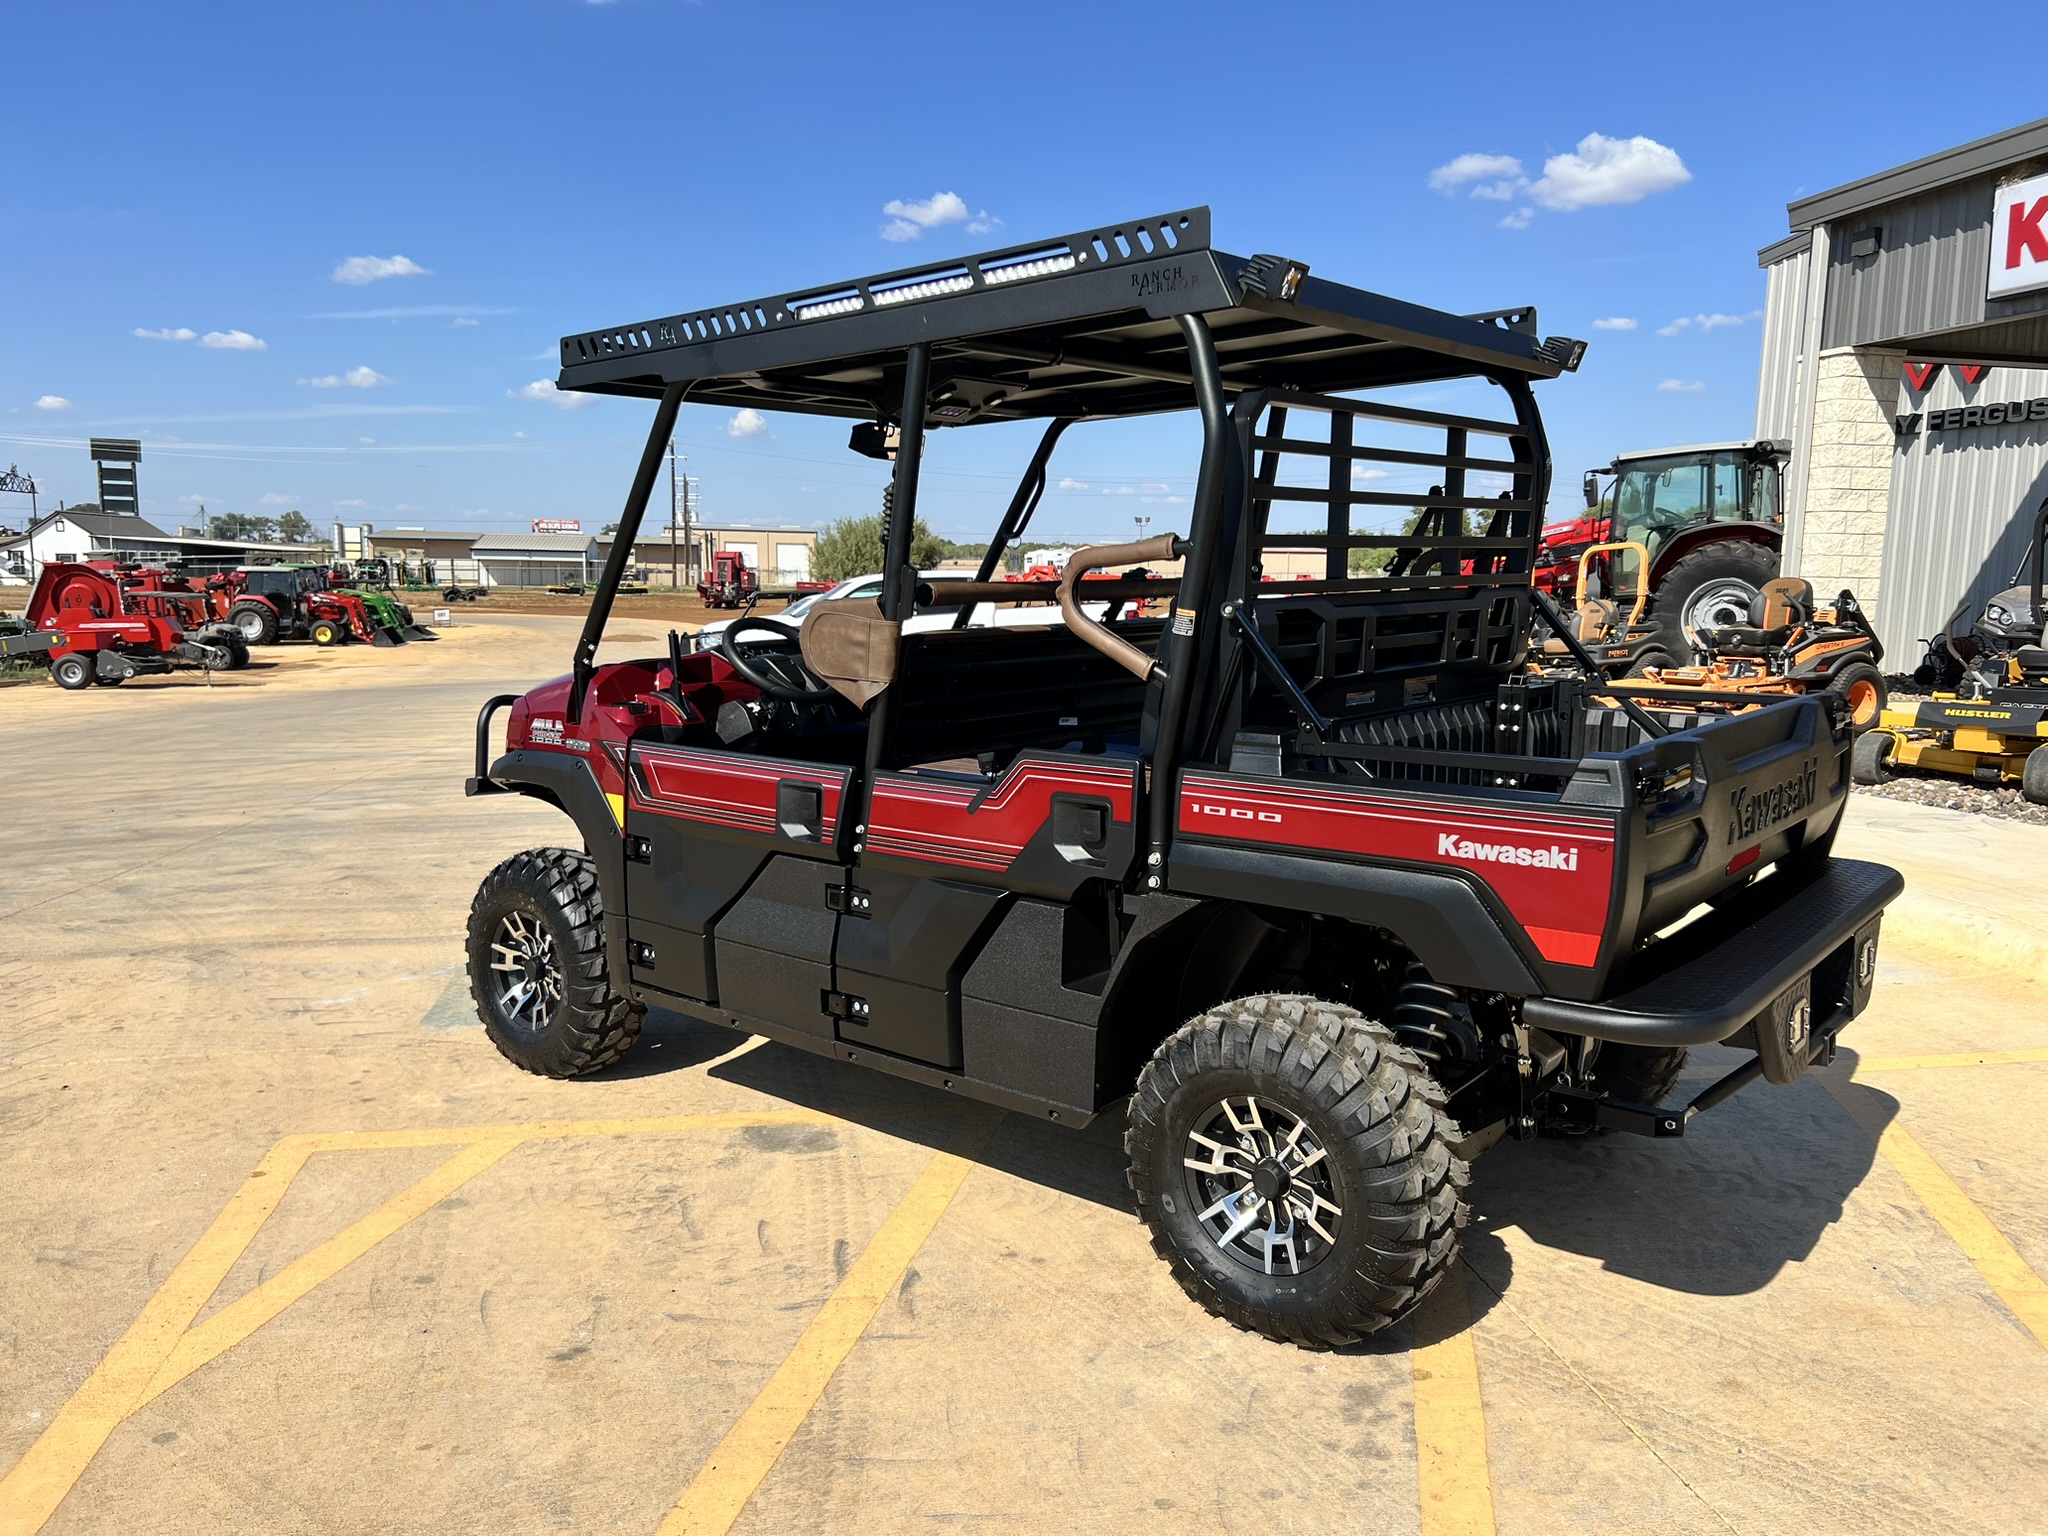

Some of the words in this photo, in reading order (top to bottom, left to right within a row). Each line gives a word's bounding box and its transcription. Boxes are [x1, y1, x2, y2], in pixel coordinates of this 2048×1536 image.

[1131, 267, 1182, 288] RANCH
[1944, 708, 2012, 719] HUSTLER
[1727, 755, 1818, 845] Kawasaki
[1191, 803, 1282, 823] 1000
[1438, 833, 1578, 871] Kawasaki
